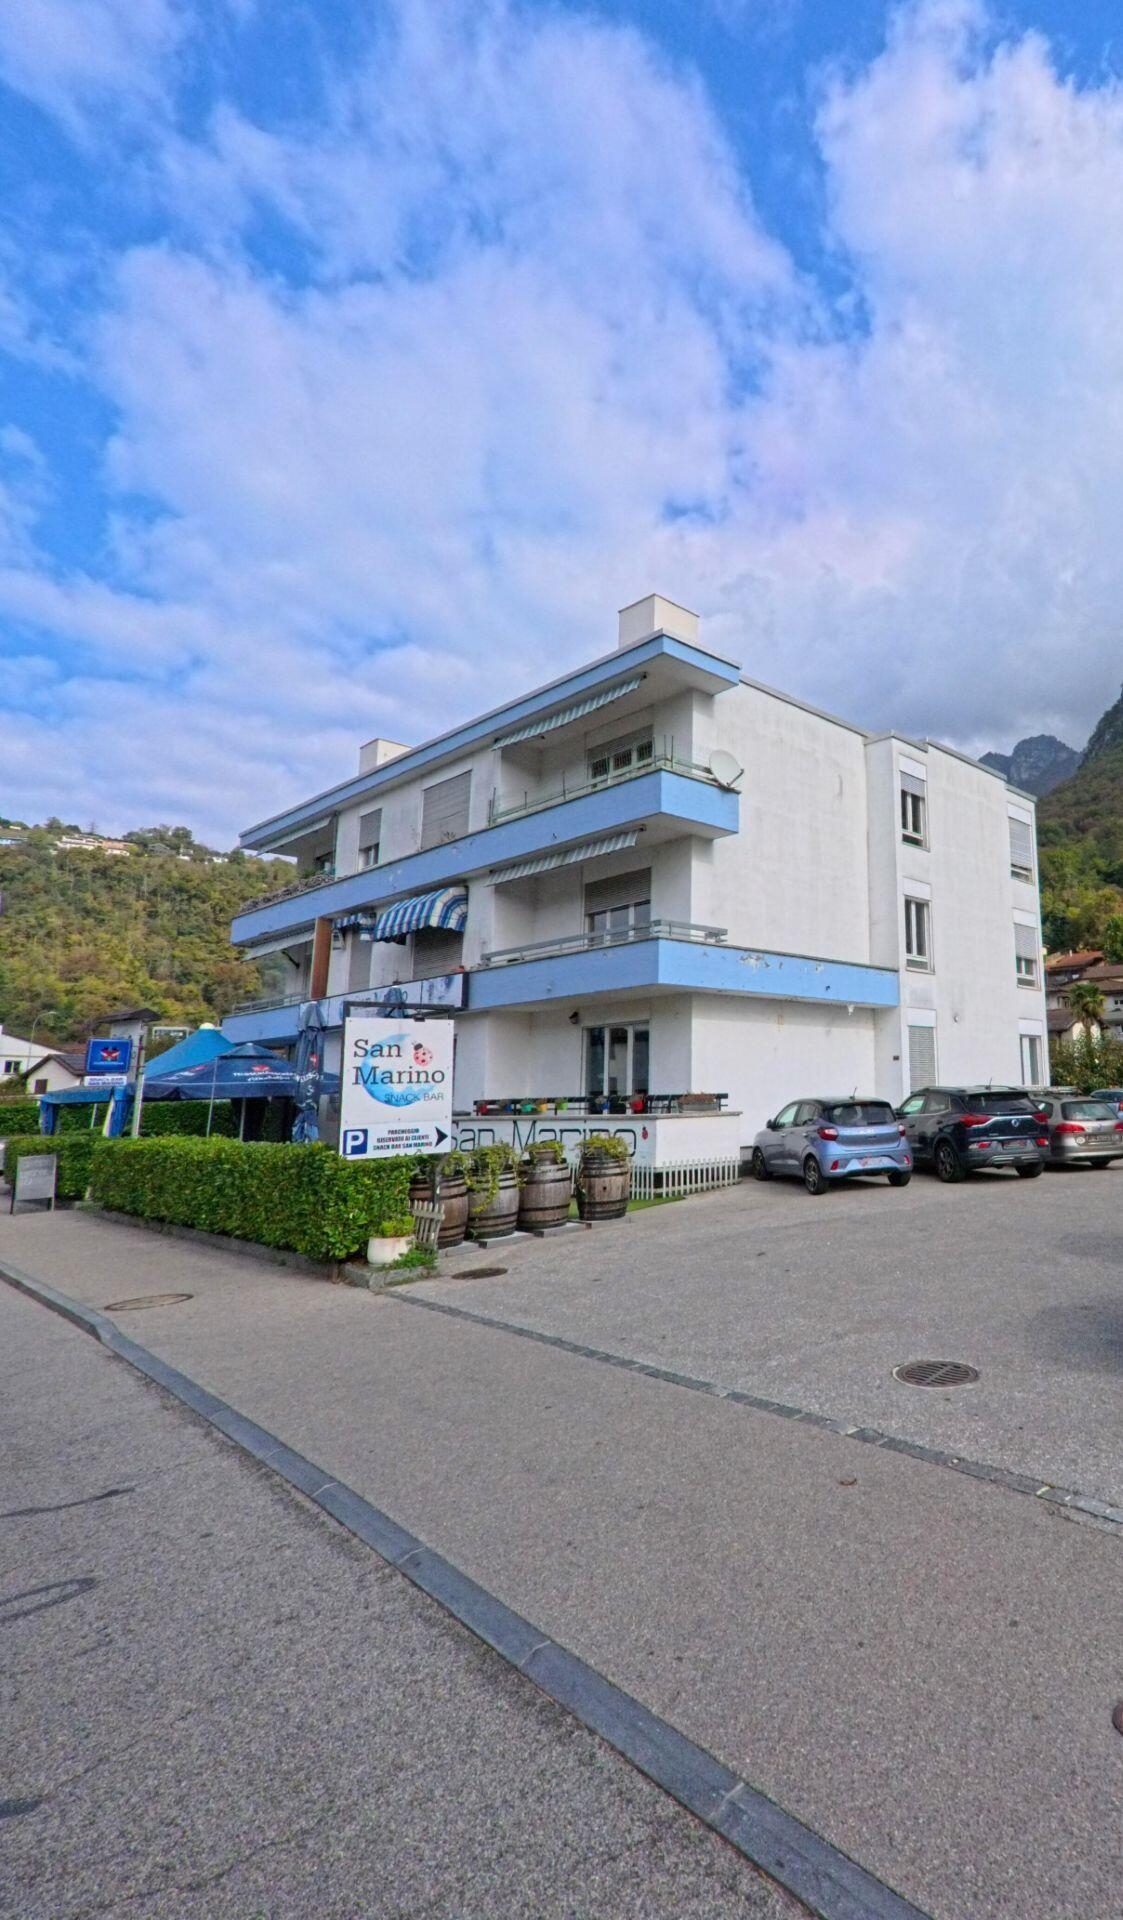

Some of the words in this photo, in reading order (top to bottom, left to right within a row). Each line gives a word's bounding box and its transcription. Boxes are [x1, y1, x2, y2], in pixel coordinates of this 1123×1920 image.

[353, 1038, 402, 1058] San
[352, 1065, 445, 1086] Marino
[384, 1093, 421, 1103] SNACK
[423, 1092, 445, 1102] BAR
[345, 1131, 365, 1154] P
